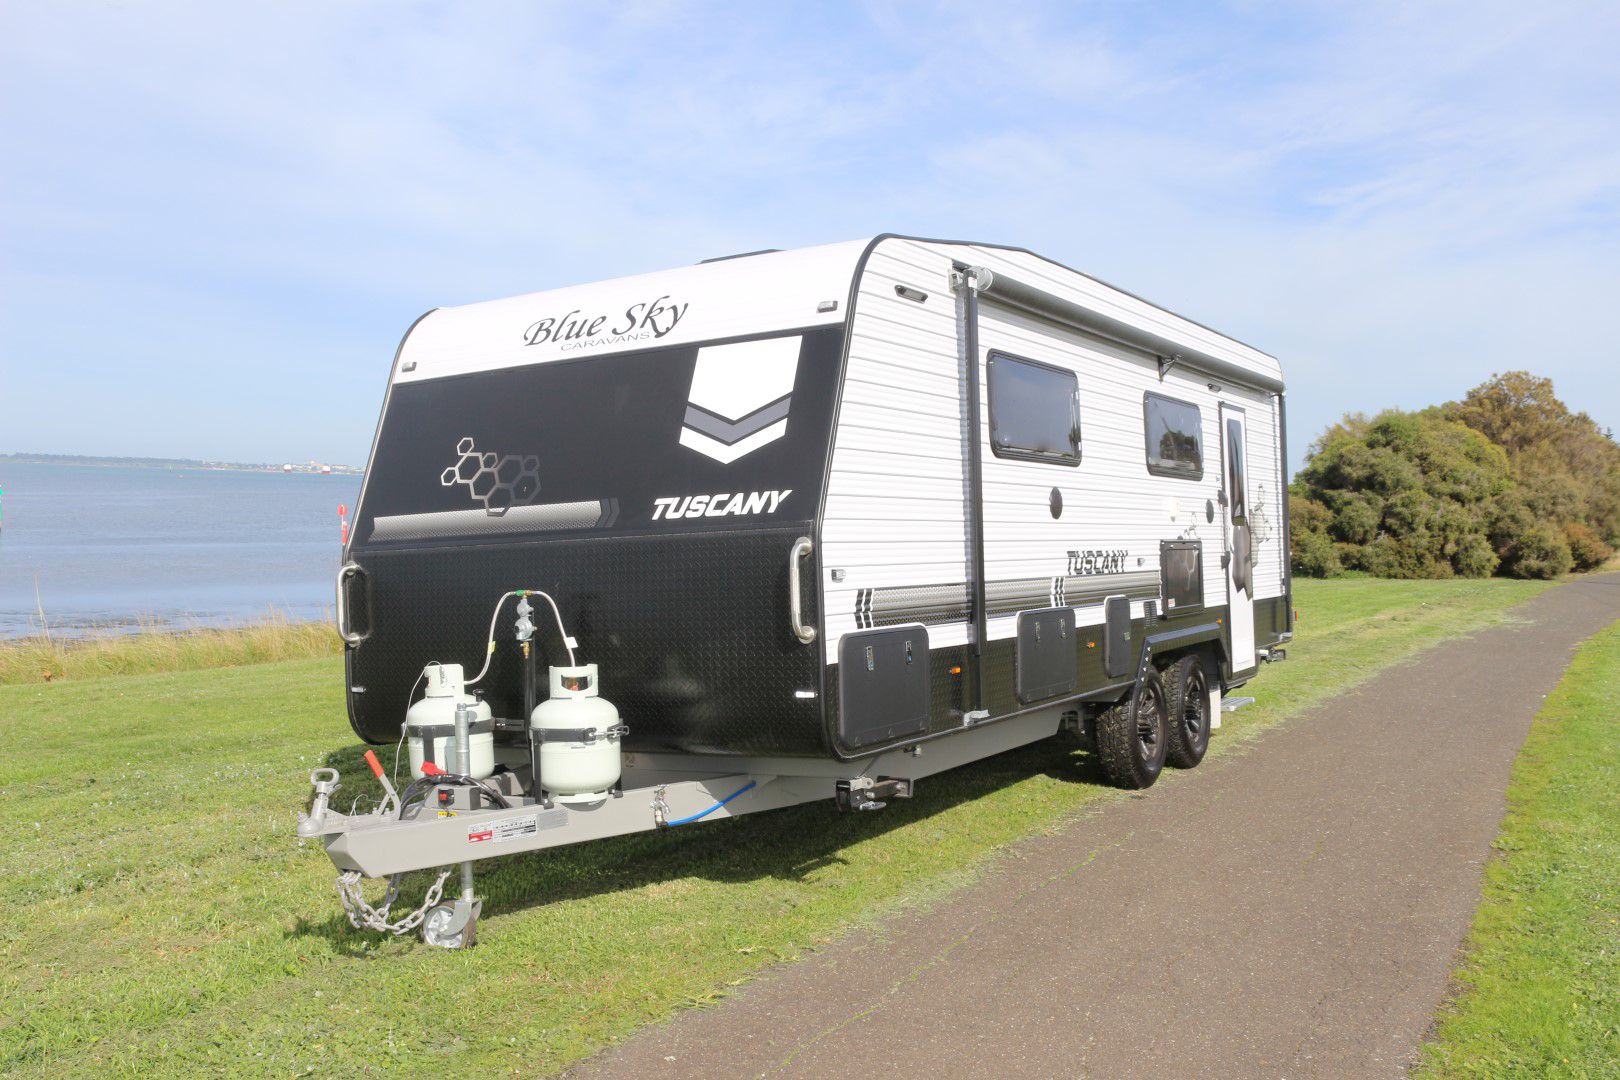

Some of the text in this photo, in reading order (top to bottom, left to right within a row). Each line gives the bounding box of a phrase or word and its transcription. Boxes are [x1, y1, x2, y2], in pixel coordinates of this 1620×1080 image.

[524, 295, 689, 346] Blue Sky
[560, 331, 650, 351] CARAVANS
[651, 489, 793, 521] TUSCANY
[1066, 549, 1128, 575] TUSCANY
